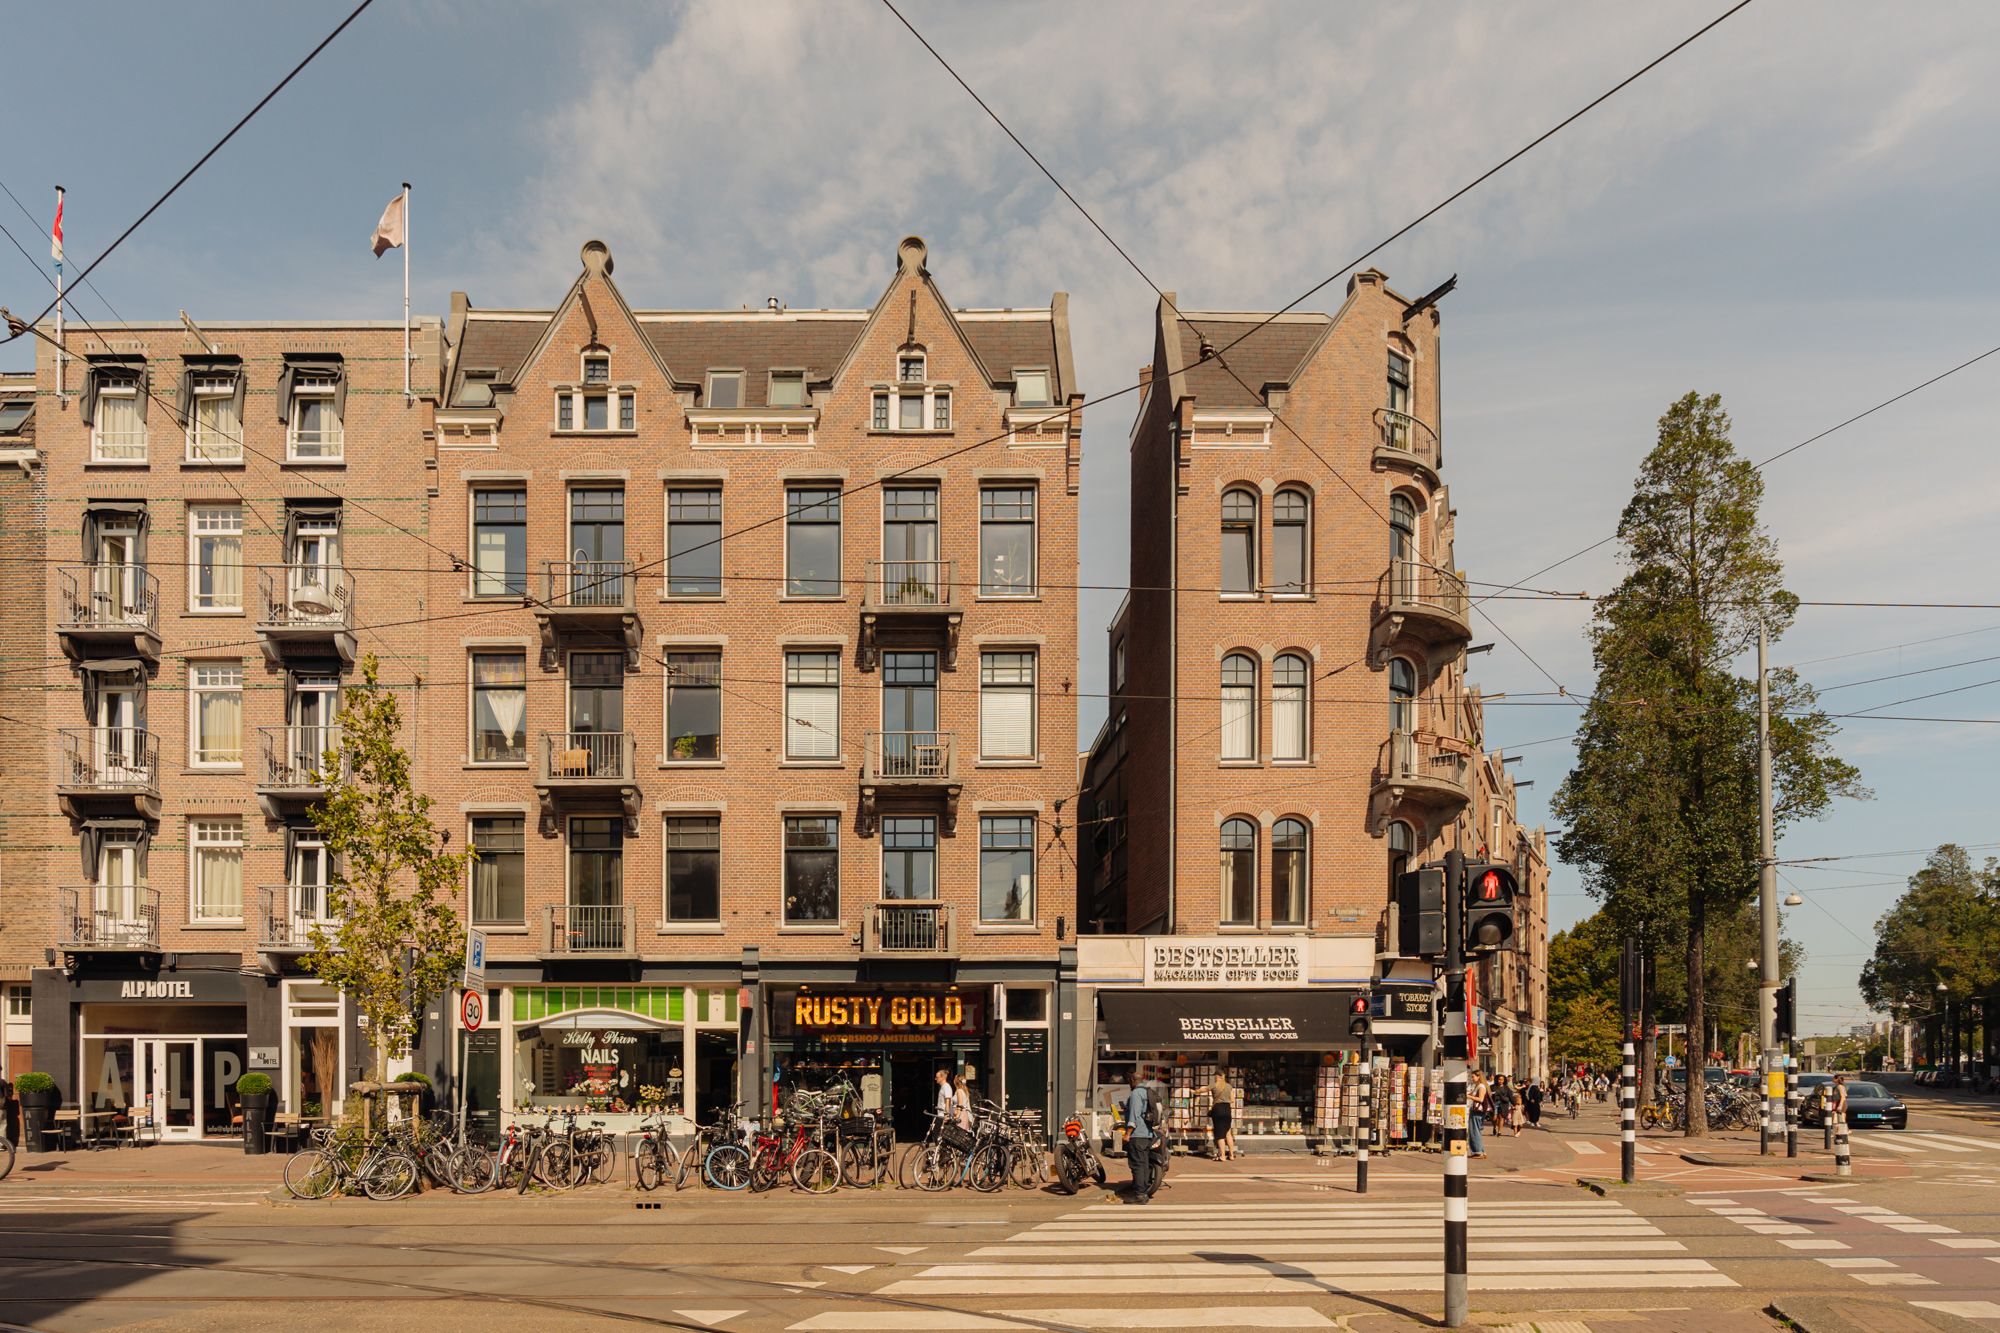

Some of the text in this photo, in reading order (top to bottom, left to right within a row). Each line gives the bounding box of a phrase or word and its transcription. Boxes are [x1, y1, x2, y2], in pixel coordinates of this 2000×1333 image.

[1154, 946, 1299, 967] BESTSELLER
[1154, 969, 1299, 981] MAGAZINES GIFTS BOOKS
[1399, 993, 1431, 1002] TOBACCO
[467, 1003, 480, 1019] 30
[795, 996, 883, 1025] RUSTY
[891, 996, 962, 1025] GOLD
[1406, 1003, 1427, 1012] STORE
[1179, 1018, 1295, 1031] BESTSELLER
[821, 1034, 936, 1043] MOTORSHOP AMSTERDAM
[1183, 1032, 1298, 1040] MAGAZINES GIFTS BOOKS
[581, 1049, 619, 1064] NAILS
